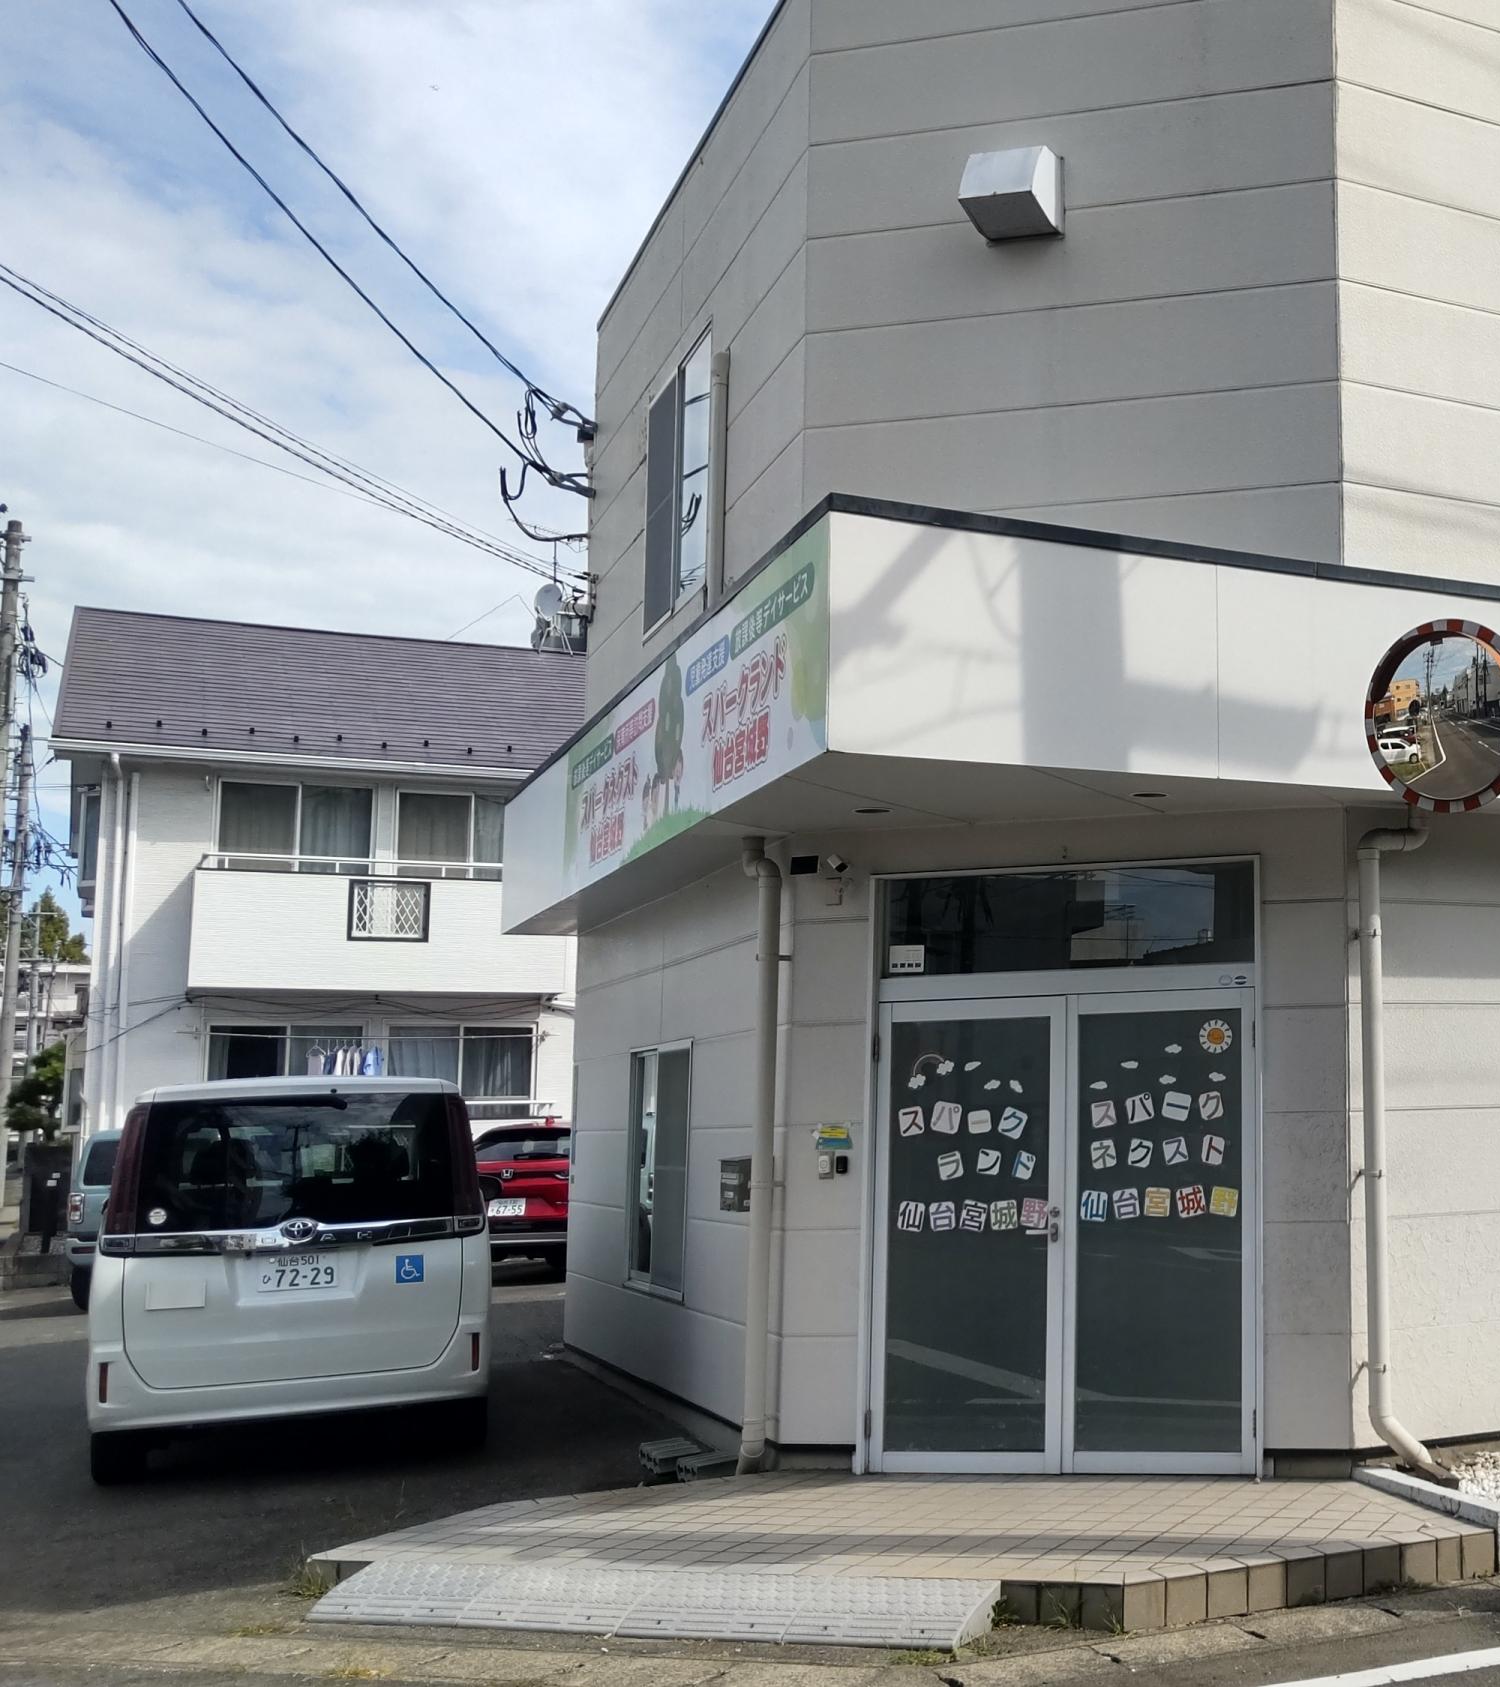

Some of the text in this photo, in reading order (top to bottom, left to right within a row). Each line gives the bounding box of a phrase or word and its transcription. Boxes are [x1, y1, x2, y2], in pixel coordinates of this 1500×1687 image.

[704, 637, 786, 740] スパークランド
[713, 711, 769, 786] 仙台宮城野
[902, 1105, 1025, 1134] スパーク
[1093, 1093, 1221, 1125] スパーク
[940, 1150, 1034, 1177] ランド
[1092, 1136, 1223, 1168] ネクスト
[899, 1198, 1048, 1231] 仙台宮城野
[1081, 1186, 1237, 1219] 仙台宮城野
[275, 1266, 335, 1288] 72-29
